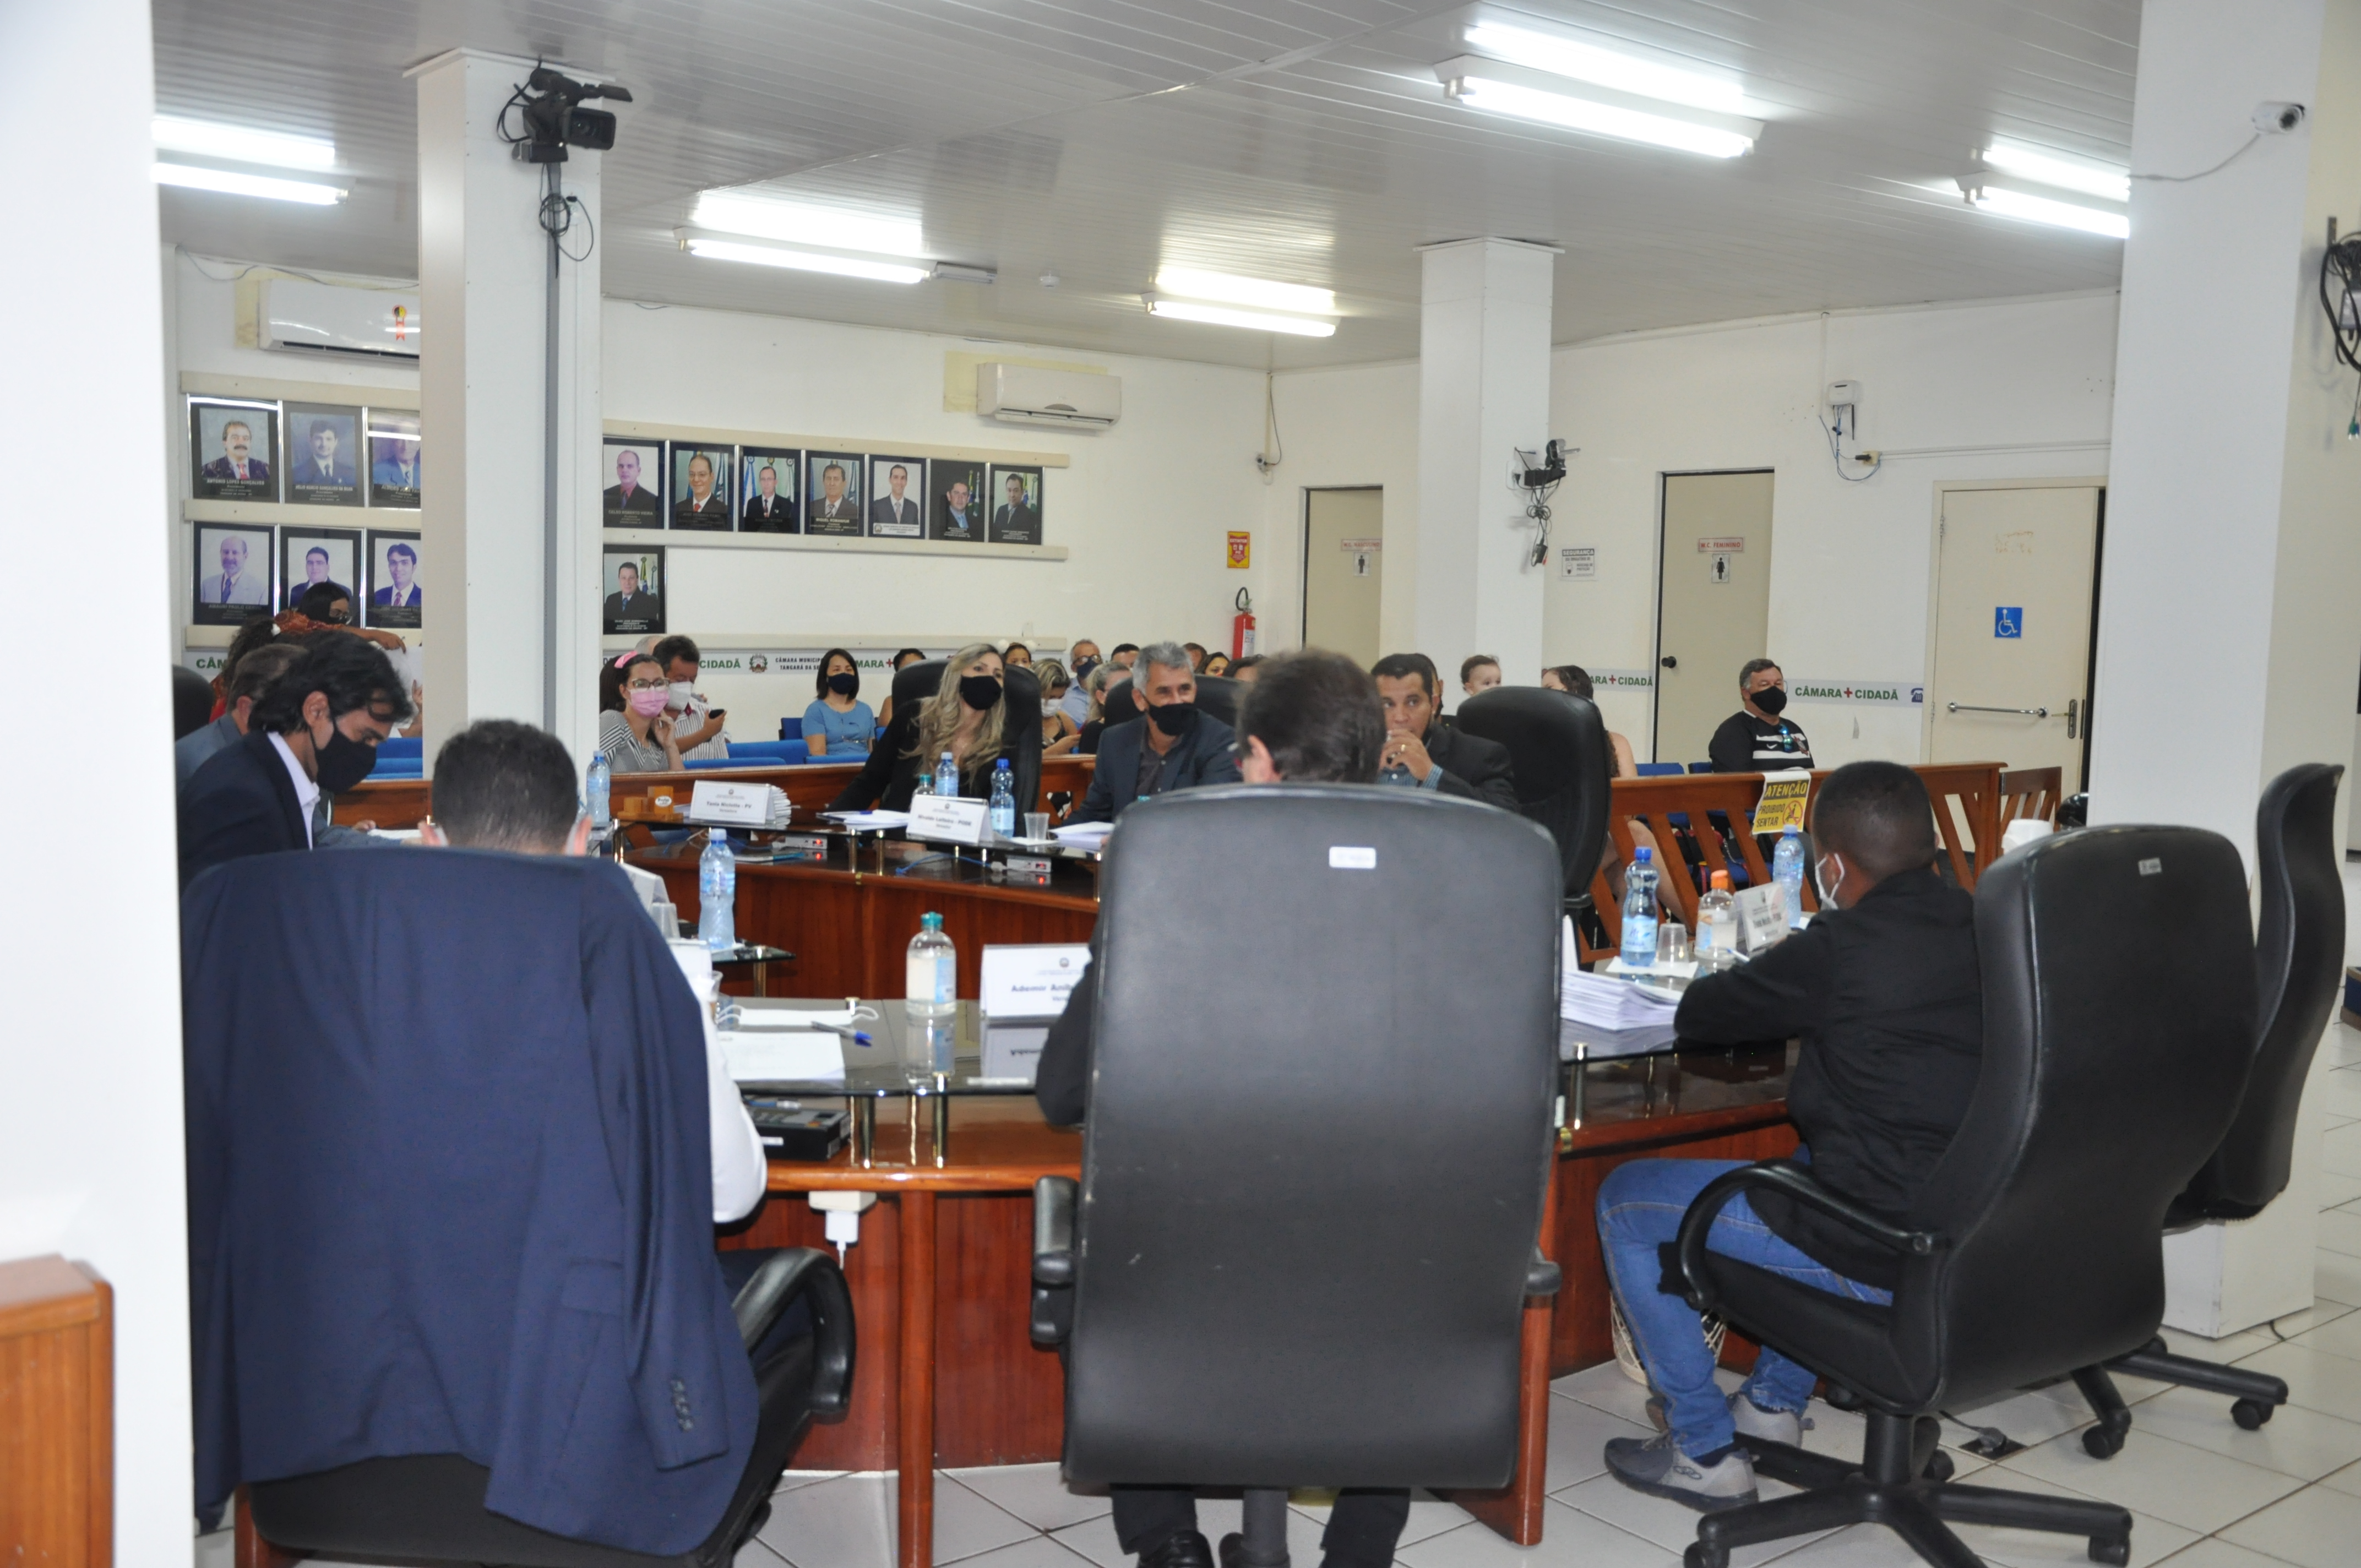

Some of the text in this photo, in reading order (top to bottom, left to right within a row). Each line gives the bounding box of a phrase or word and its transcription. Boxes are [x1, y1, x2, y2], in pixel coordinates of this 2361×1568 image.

[699, 658, 741, 669] CIDADÃ
[1618, 676, 1653, 687] CIDADÃ
[1795, 685, 1842, 698] CÂMARA
[1854, 689, 1898, 700] CIDADÃ
[1765, 780, 1808, 798] ATENÇÃO
[1756, 817, 1779, 827] SENTAR
